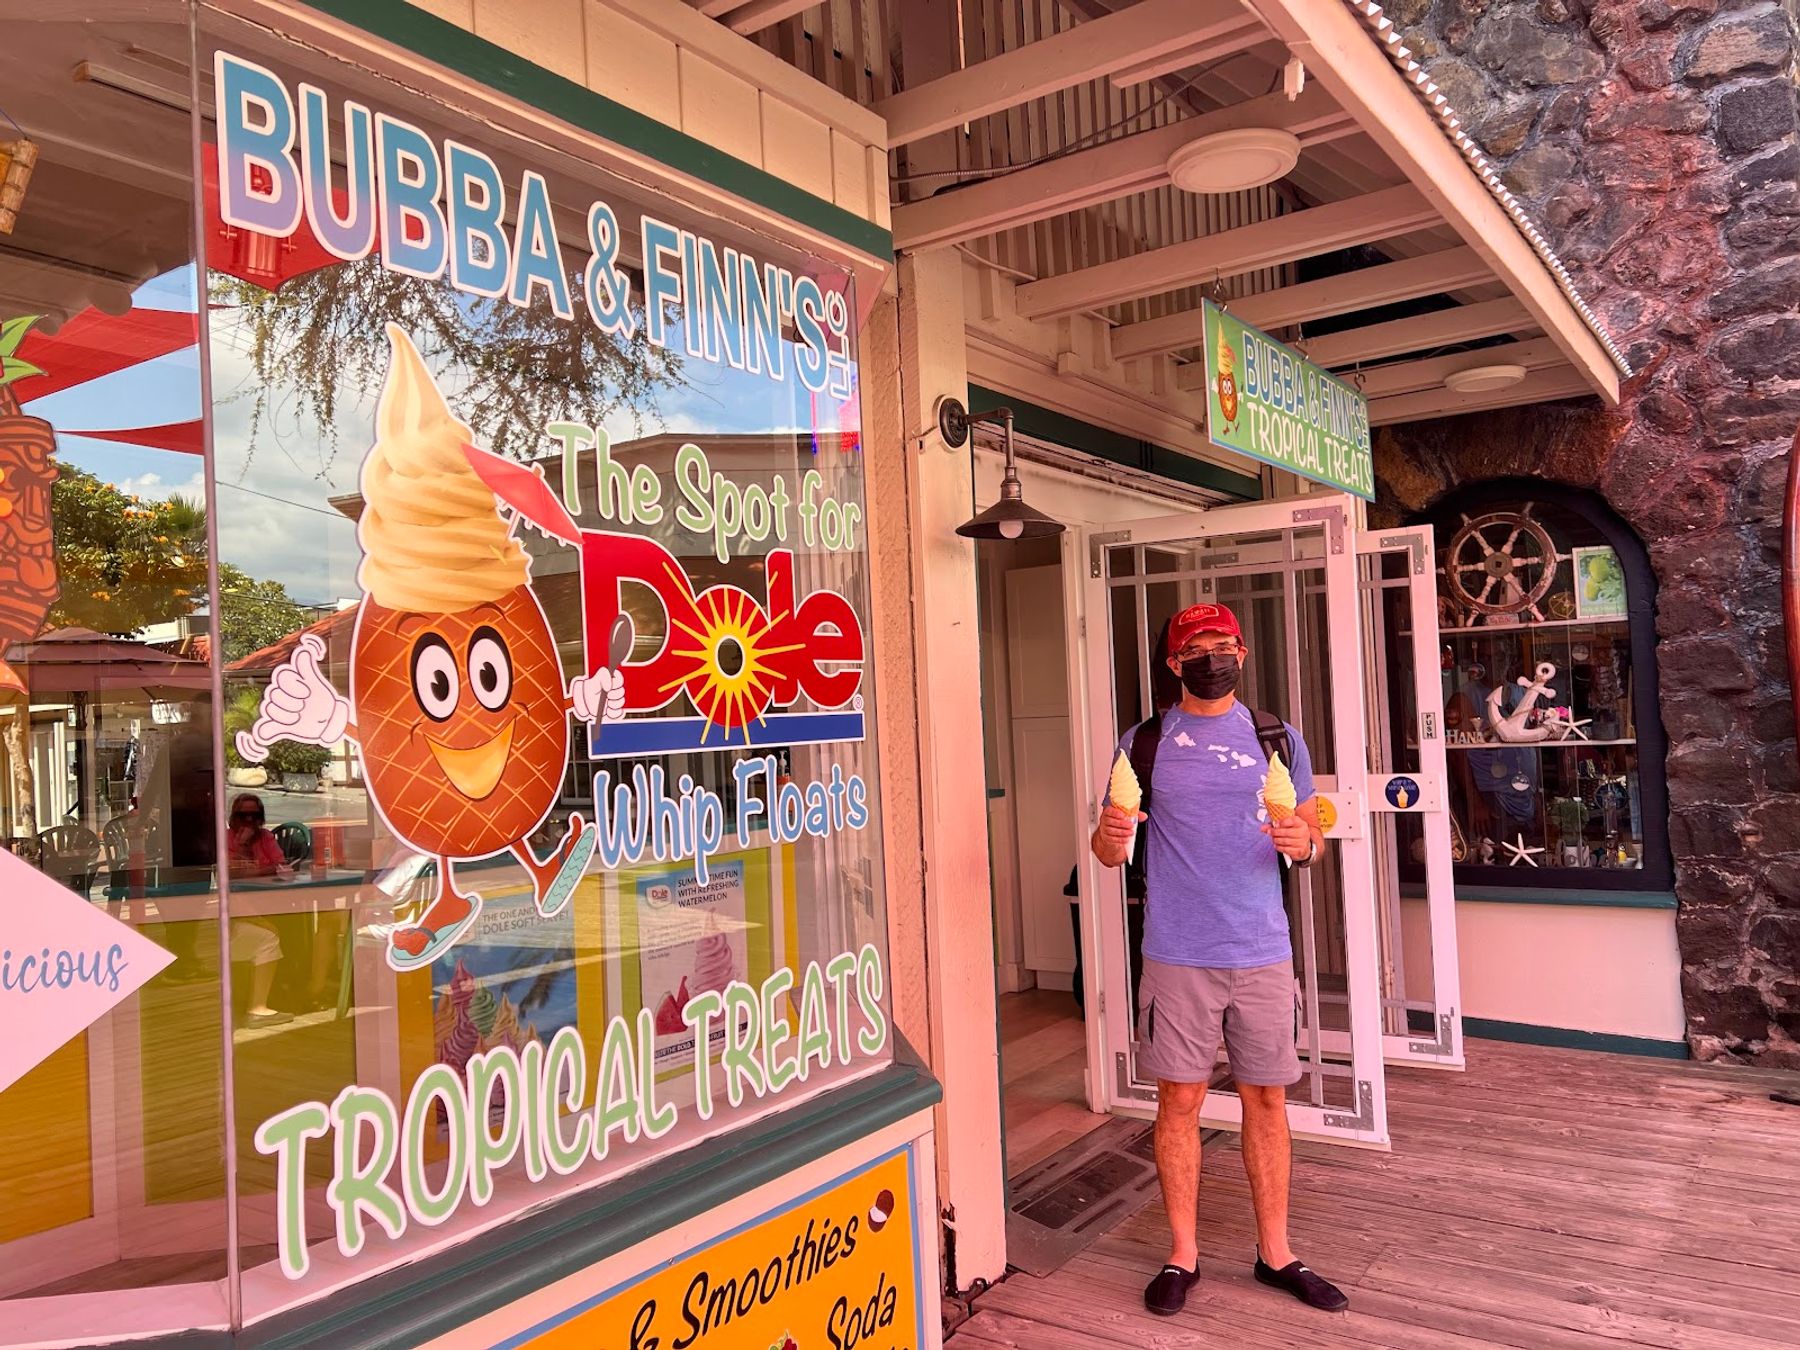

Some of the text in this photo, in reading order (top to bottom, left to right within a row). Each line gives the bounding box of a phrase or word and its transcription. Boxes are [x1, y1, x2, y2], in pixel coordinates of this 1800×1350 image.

[214, 50, 829, 393] BUBBA & FINN'S
[1243, 331, 1364, 450] BUBBA & FINN'S
[1247, 402, 1373, 494] TROPICAL TREATS
[548, 421, 861, 564] The Spot for
[579, 528, 865, 728] Dole
[1425, 714, 1433, 739] PUSH
[1445, 729, 1486, 744] HANA
[594, 754, 868, 886] Whip Floats
[483, 906, 537, 923] THE ONE AND
[678, 879, 739, 897] WITH REFRESHING
[678, 892, 728, 907] WATERMELON
[725, 869, 738, 879] FUN
[483, 921, 510, 935] DOLE
[511, 916, 535, 930] SOFT
[254, 943, 888, 1281] TROPICAL TREATS
[671, 1215, 860, 1350] Smoothies
[826, 1272, 897, 1350] Soda
